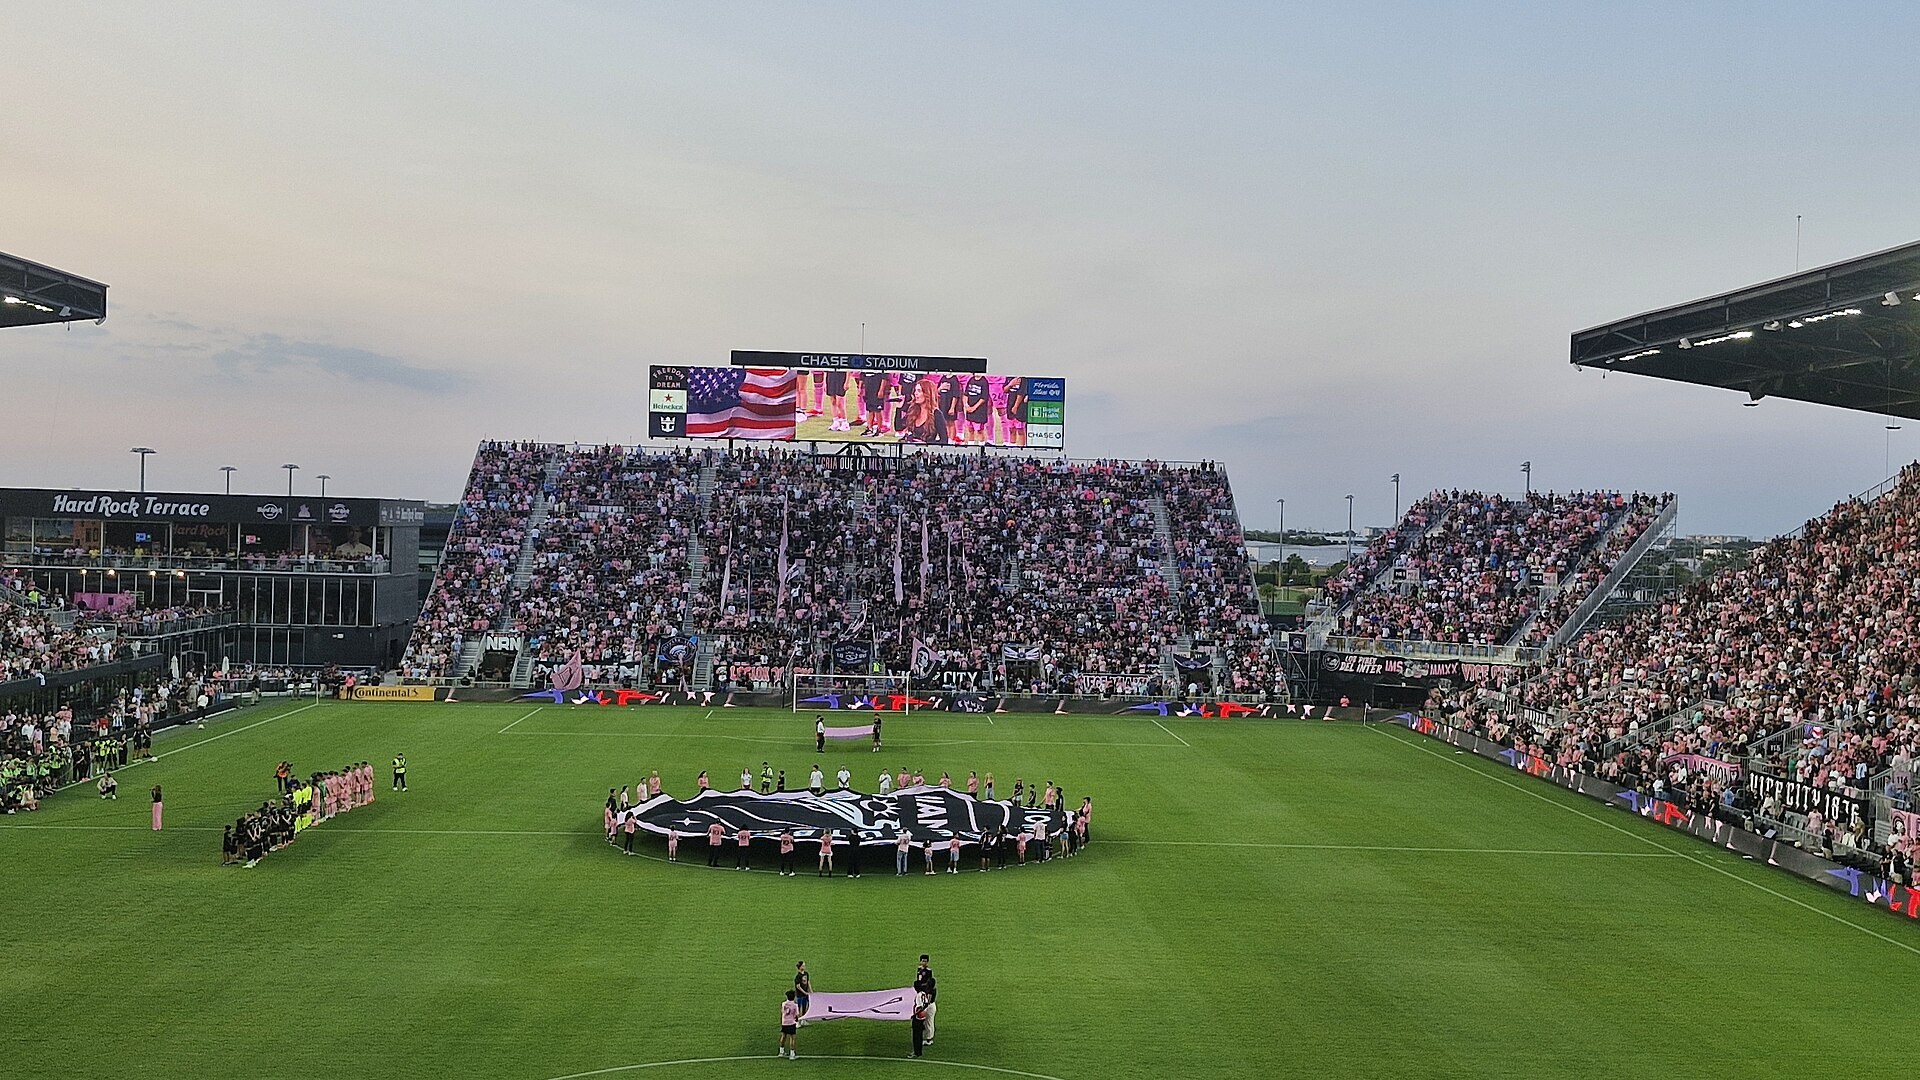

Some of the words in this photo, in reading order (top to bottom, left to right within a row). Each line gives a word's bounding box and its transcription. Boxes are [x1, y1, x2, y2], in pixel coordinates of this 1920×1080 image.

[801, 355, 849, 367] CHASE
[865, 357, 919, 369] STADIUM
[653, 367, 685, 380] FREEDOM
[1033, 381, 1060, 389] Florida
[652, 403, 684, 411] Heineken
[1028, 431, 1054, 439] CHASE
[840, 457, 854, 471] QUE
[869, 458, 883, 471] MLS
[53, 494, 98, 513] Hard
[98, 496, 139, 517] Rock
[145, 496, 210, 516] Terrace
[1339, 661, 1355, 672] DEL
[1355, 663, 1382, 675] INTER
[943, 671, 978, 689] CITY
[354, 687, 410, 698] Continental
[1785, 782, 1821, 812] CITY
